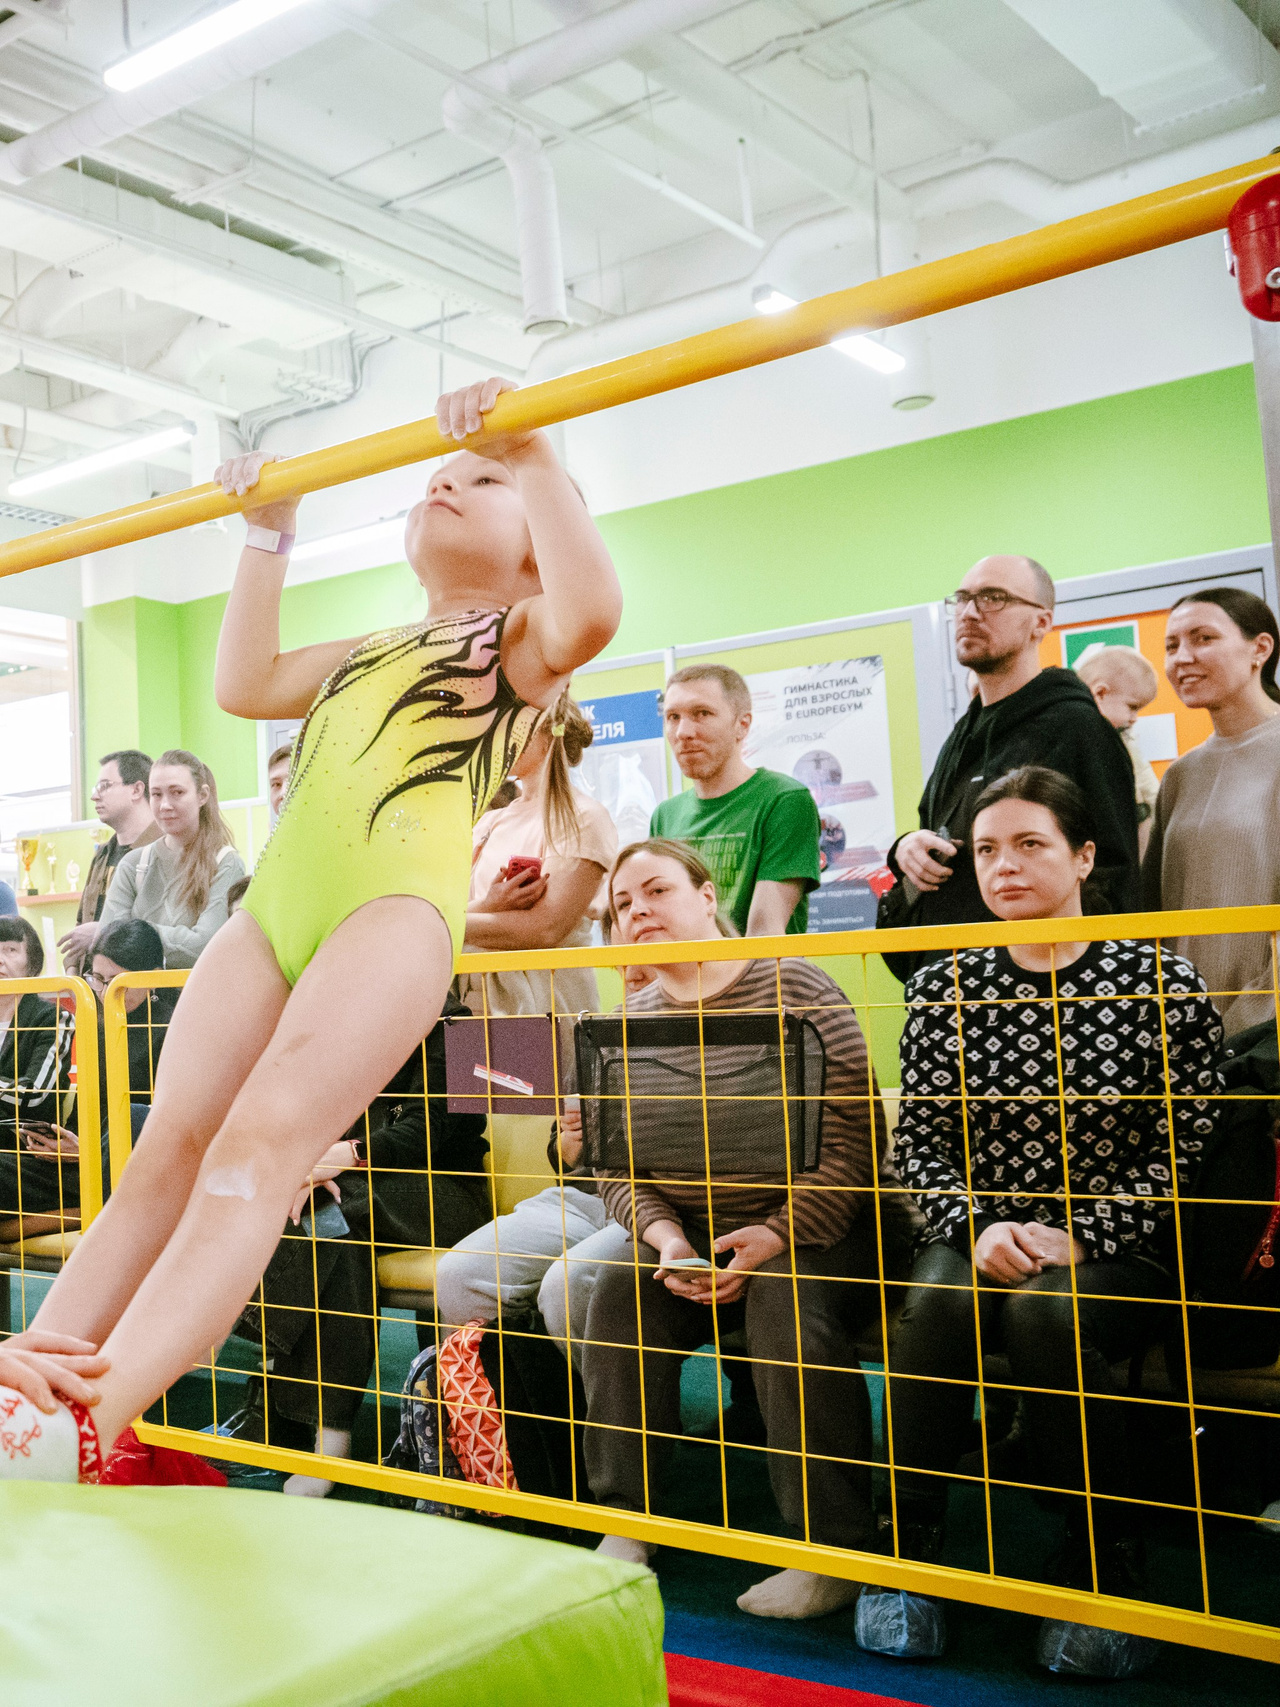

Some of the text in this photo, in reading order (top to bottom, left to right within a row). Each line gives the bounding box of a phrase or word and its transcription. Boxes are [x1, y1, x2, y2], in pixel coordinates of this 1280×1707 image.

[784, 676, 859, 695] ГИМНАСТИКА
[784, 695, 808, 709] ДЛЯ
[811, 687, 873, 704] ВЗРОСЛЫХ
[578, 704, 596, 720] ОК
[796, 702, 863, 719] EUROPEGYM
[591, 721, 625, 740] ЕЛЯ
